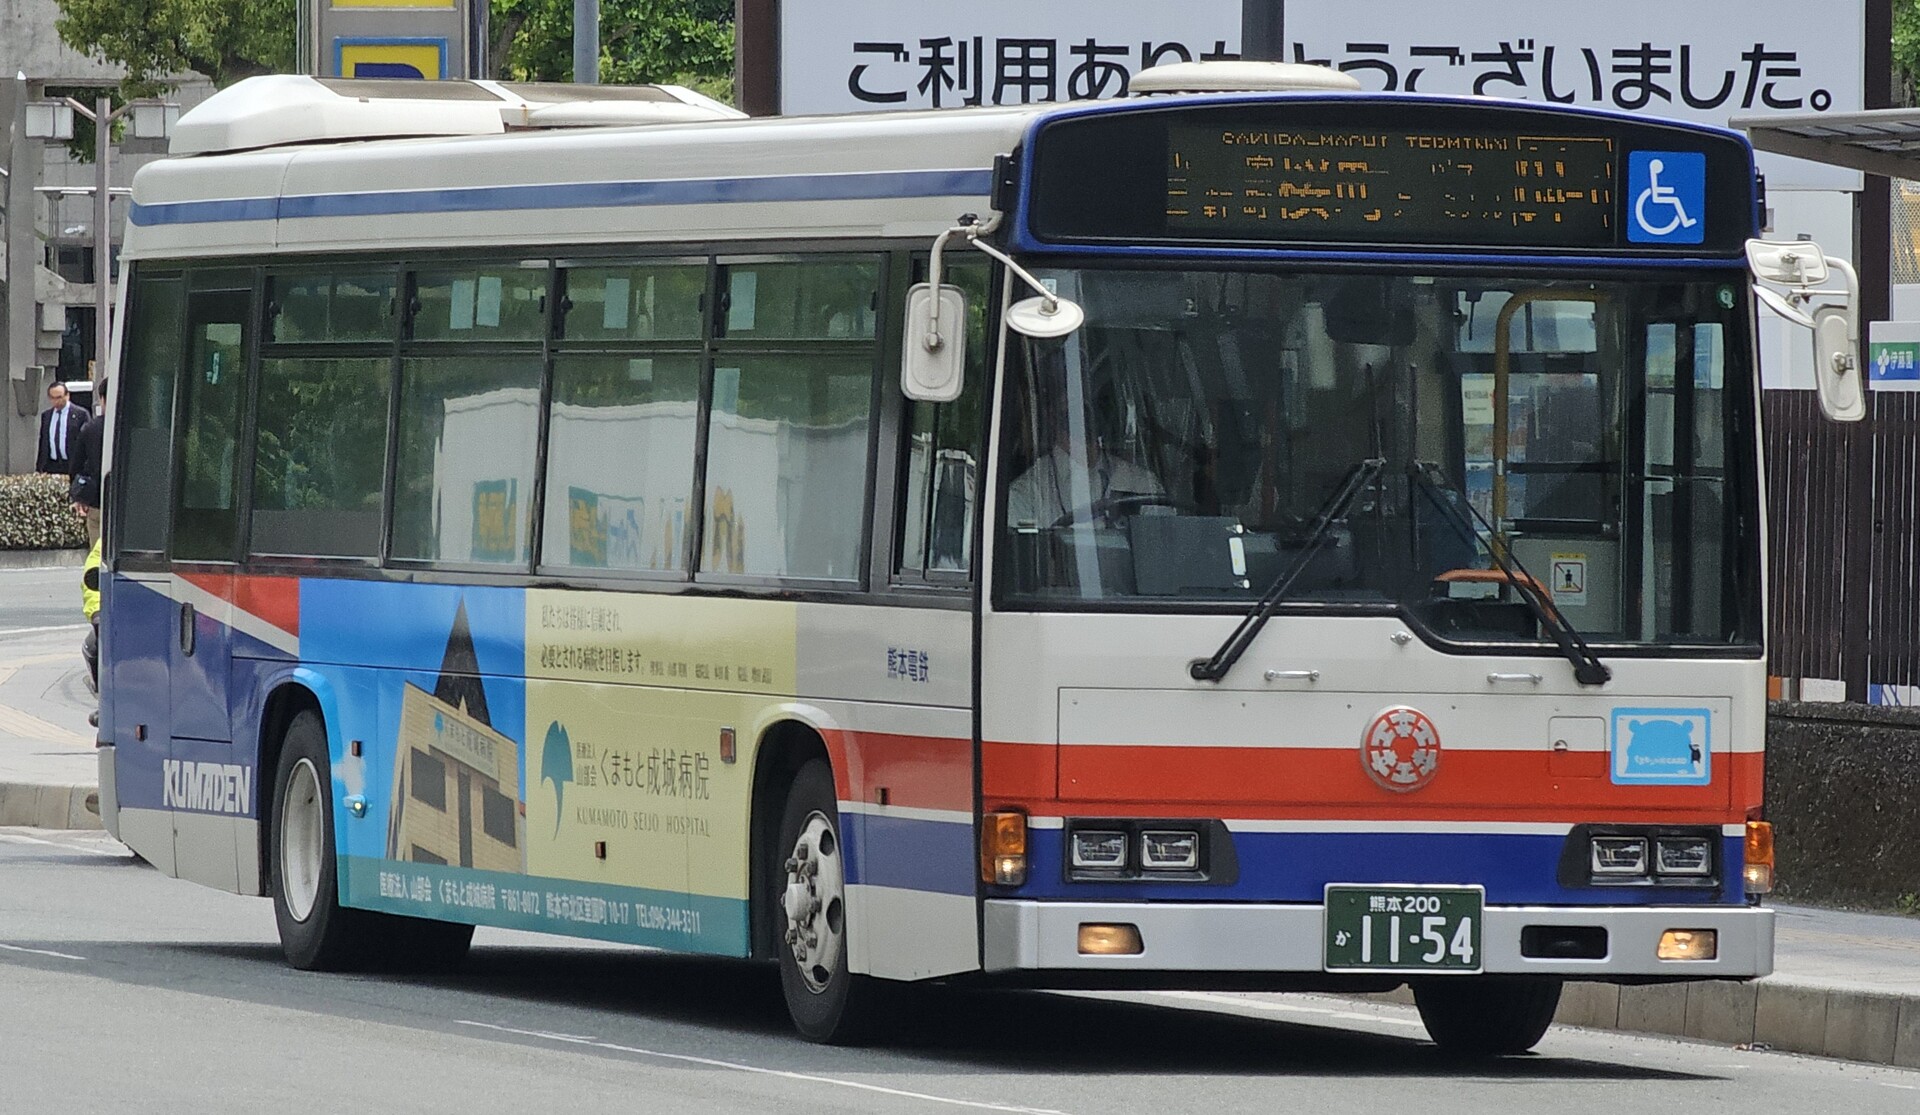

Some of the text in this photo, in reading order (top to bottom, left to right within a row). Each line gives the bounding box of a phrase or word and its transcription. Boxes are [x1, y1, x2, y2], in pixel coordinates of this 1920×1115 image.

[847, 36, 1833, 110] ご利用ありうございました。
[887, 646, 929, 683] 熊本電鉄
[163, 759, 251, 814] KUMADEN
[600, 748, 710, 800] くまもと成城病院
[576, 807, 710, 837] KUMAMOTO SEIJO HOSPITAL
[1361, 915, 1474, 964] 11-54
